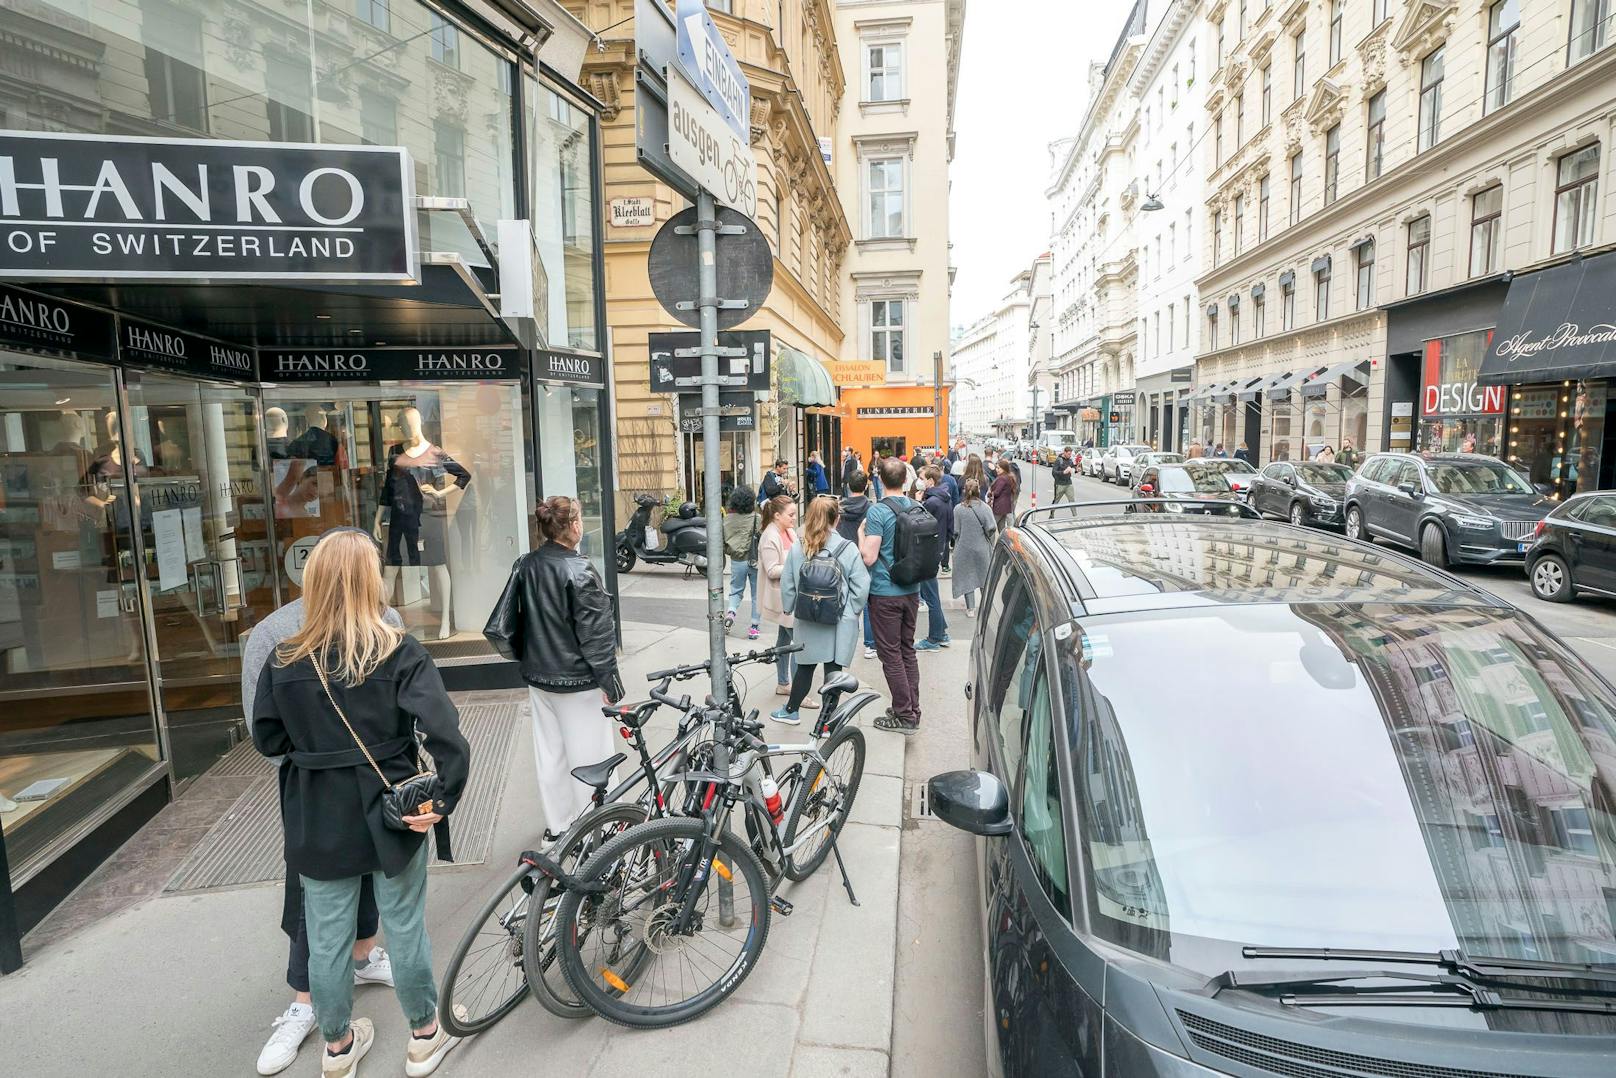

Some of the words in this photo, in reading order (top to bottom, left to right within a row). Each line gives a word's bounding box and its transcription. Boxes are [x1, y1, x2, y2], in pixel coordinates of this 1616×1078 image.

[705, 36, 744, 124] EINBAHN
[673, 100, 724, 173] ausgen.
[0, 156, 365, 226] HANRO
[613, 206, 651, 218] Kleeblatt
[8, 230, 57, 253] OF
[92, 233, 355, 258] SWITZERLAND
[0, 294, 70, 334] ANRO
[128, 326, 185, 357] HANRO
[1496, 330, 1552, 361] Agent
[210, 345, 250, 370] HANRO
[278, 354, 367, 370] HANRO
[418, 353, 502, 369] HANRO
[550, 355, 589, 374] HANRO
[859, 406, 933, 415] LUNETTERIE
[1425, 382, 1502, 413] DESIGN
[151, 484, 198, 506] HANRO
[218, 480, 255, 498] HANRO
[720, 960, 748, 992] KENDA
